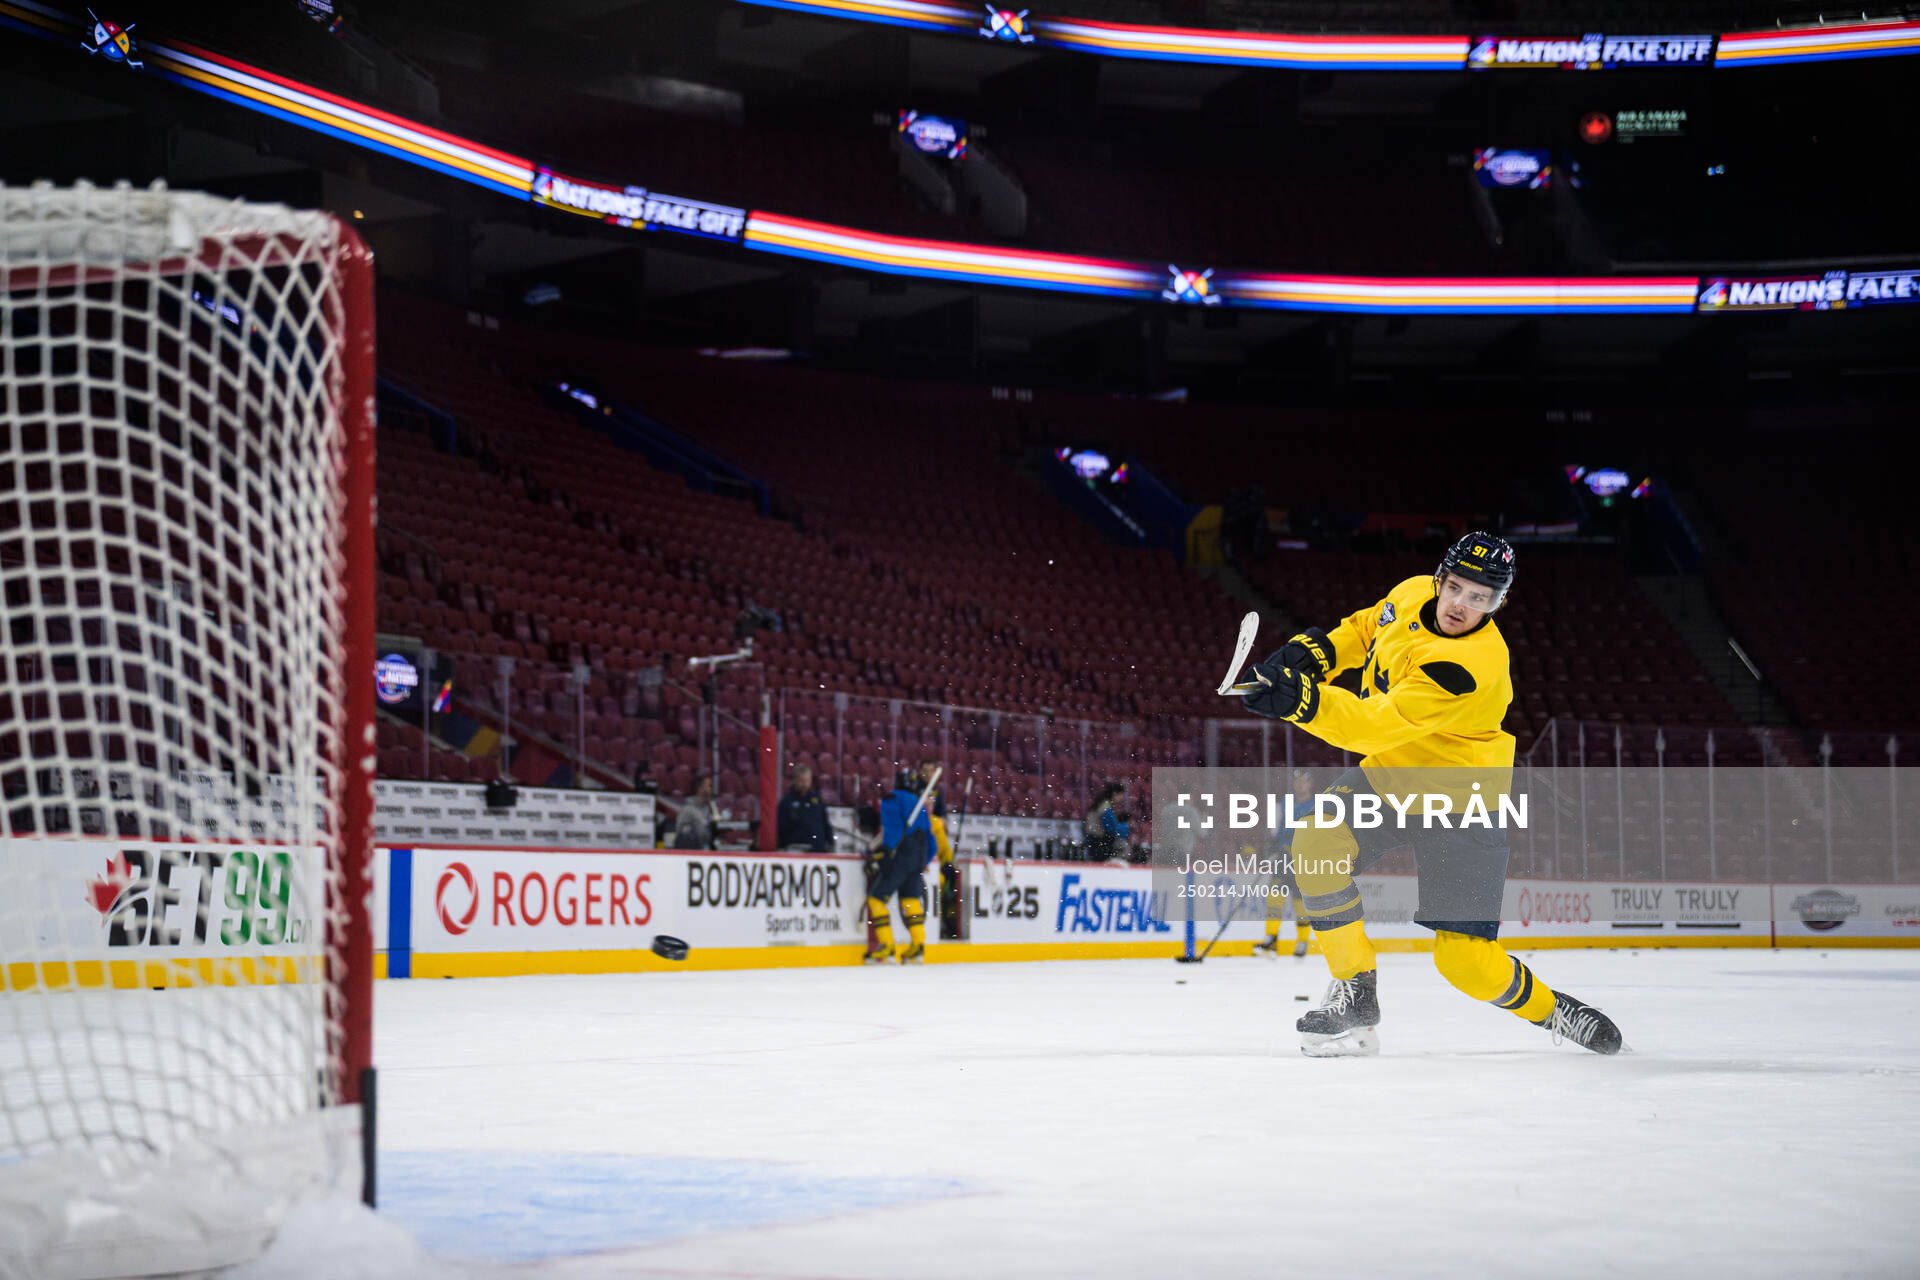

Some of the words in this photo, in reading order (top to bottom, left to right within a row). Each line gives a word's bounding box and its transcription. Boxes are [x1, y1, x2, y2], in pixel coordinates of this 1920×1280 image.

[1497, 40, 1600, 62] NATIONS
[551, 177, 644, 218] NATIONS
[1729, 280, 1846, 304] NATIONS
[1472, 545, 1488, 558] 91
[1288, 633, 1330, 674] AUER
[688, 861, 841, 908] BODYARMOR
[492, 871, 653, 927] ROGERS
[1535, 892, 1592, 923] ROGERS
[1611, 888, 1663, 910] TRULY
[1675, 888, 1740, 911] TRULY
[766, 914, 805, 934] Sports
[810, 914, 841, 931] Drink
